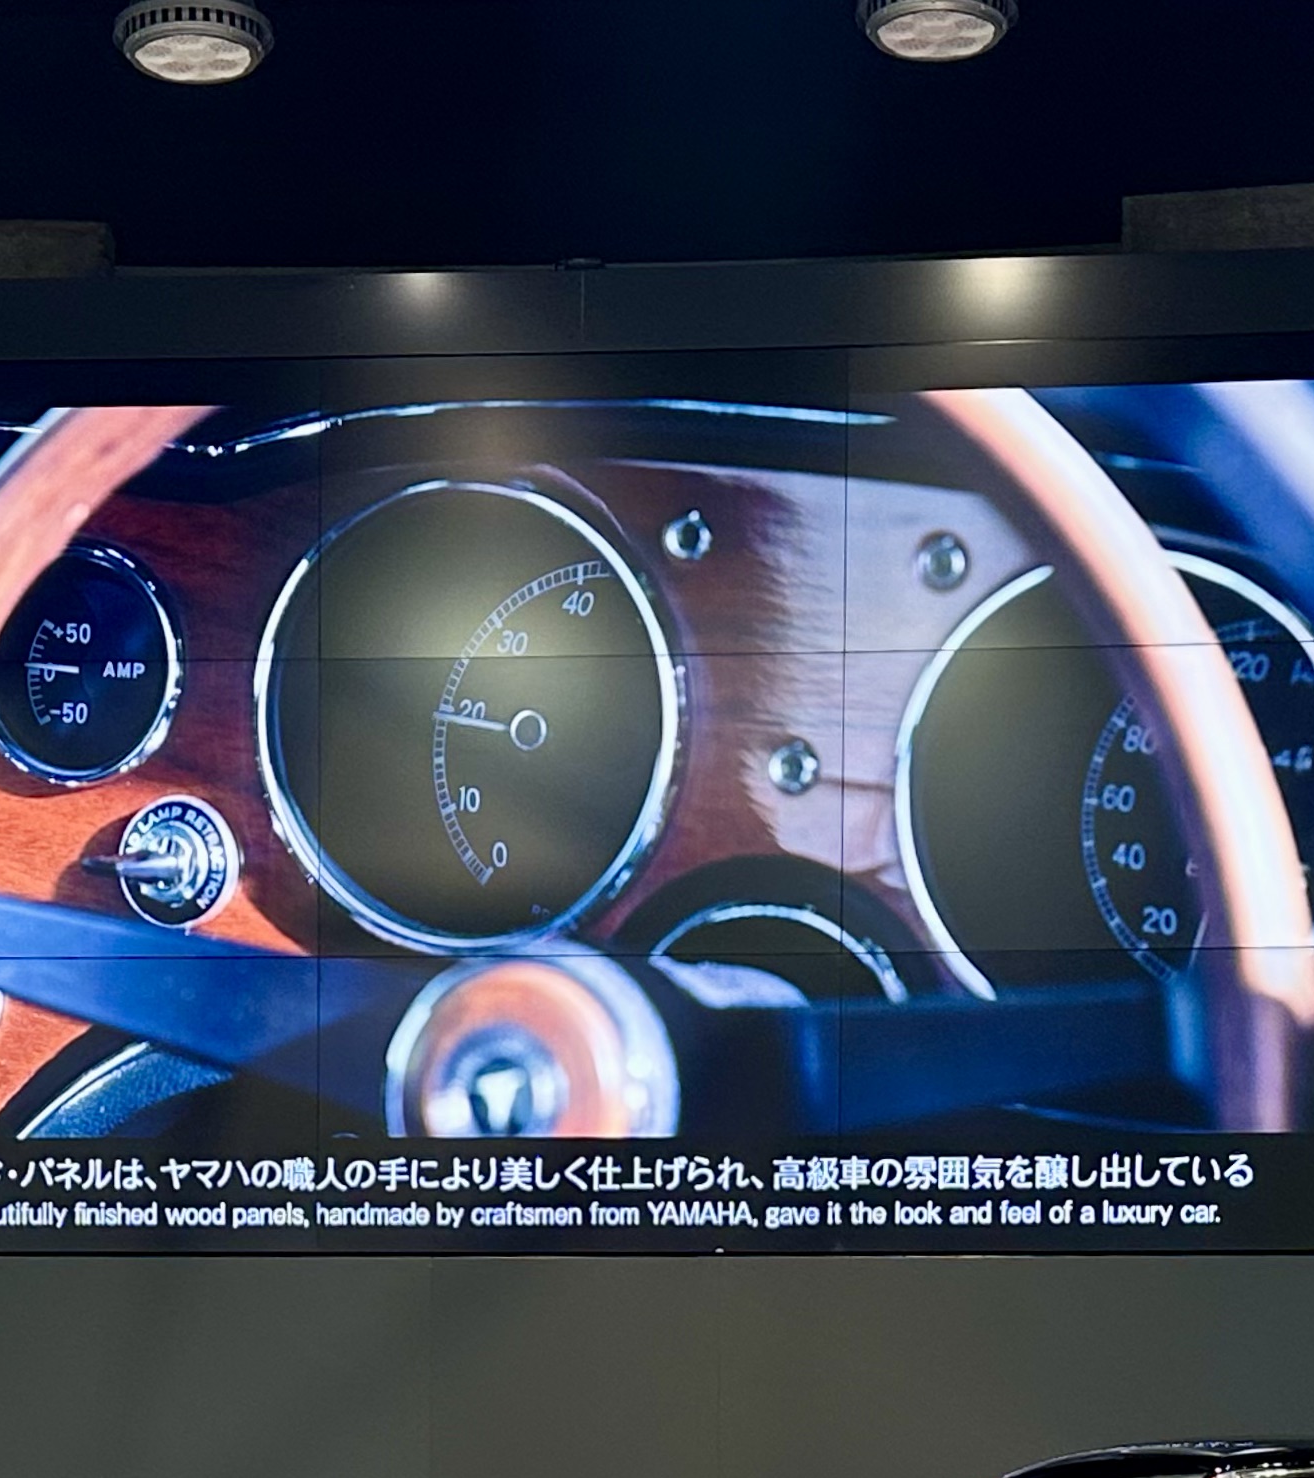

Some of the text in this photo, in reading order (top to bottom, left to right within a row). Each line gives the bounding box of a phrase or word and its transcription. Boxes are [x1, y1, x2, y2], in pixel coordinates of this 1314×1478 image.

[561, 591, 595, 617] 40
[52, 623, 92, 645] +50
[496, 631, 528, 657] 30
[102, 661, 146, 679] AMP
[49, 702, 89, 724] -50
[458, 786, 481, 813] 10
[1102, 784, 1135, 812] 60
[492, 841, 508, 868] 0
[1112, 843, 1146, 870] 40
[1143, 905, 1178, 935] 20
[74, 1202, 157, 1226] finished
[165, 1202, 226, 1226] wood
[233, 1202, 310, 1230] panels,
[317, 1202, 430, 1226] handmade
[437, 1202, 464, 1229] by
[471, 1201, 582, 1226] craftsmen
[589, 1201, 640, 1225] from
[647, 1201, 759, 1228] YAMAHA,
[765, 1207, 820, 1229] gave
[827, 1201, 842, 1225] it
[849, 1201, 887, 1225] the
[895, 1200, 943, 1224] look
[949, 1200, 992, 1224] and
[1000, 1200, 1041, 1224] feel
[1049, 1200, 1073, 1224] of
[1080, 1206, 1095, 1224] a
[1103, 1200, 1173, 1227] luxury
[1180, 1205, 1221, 1224] car.
